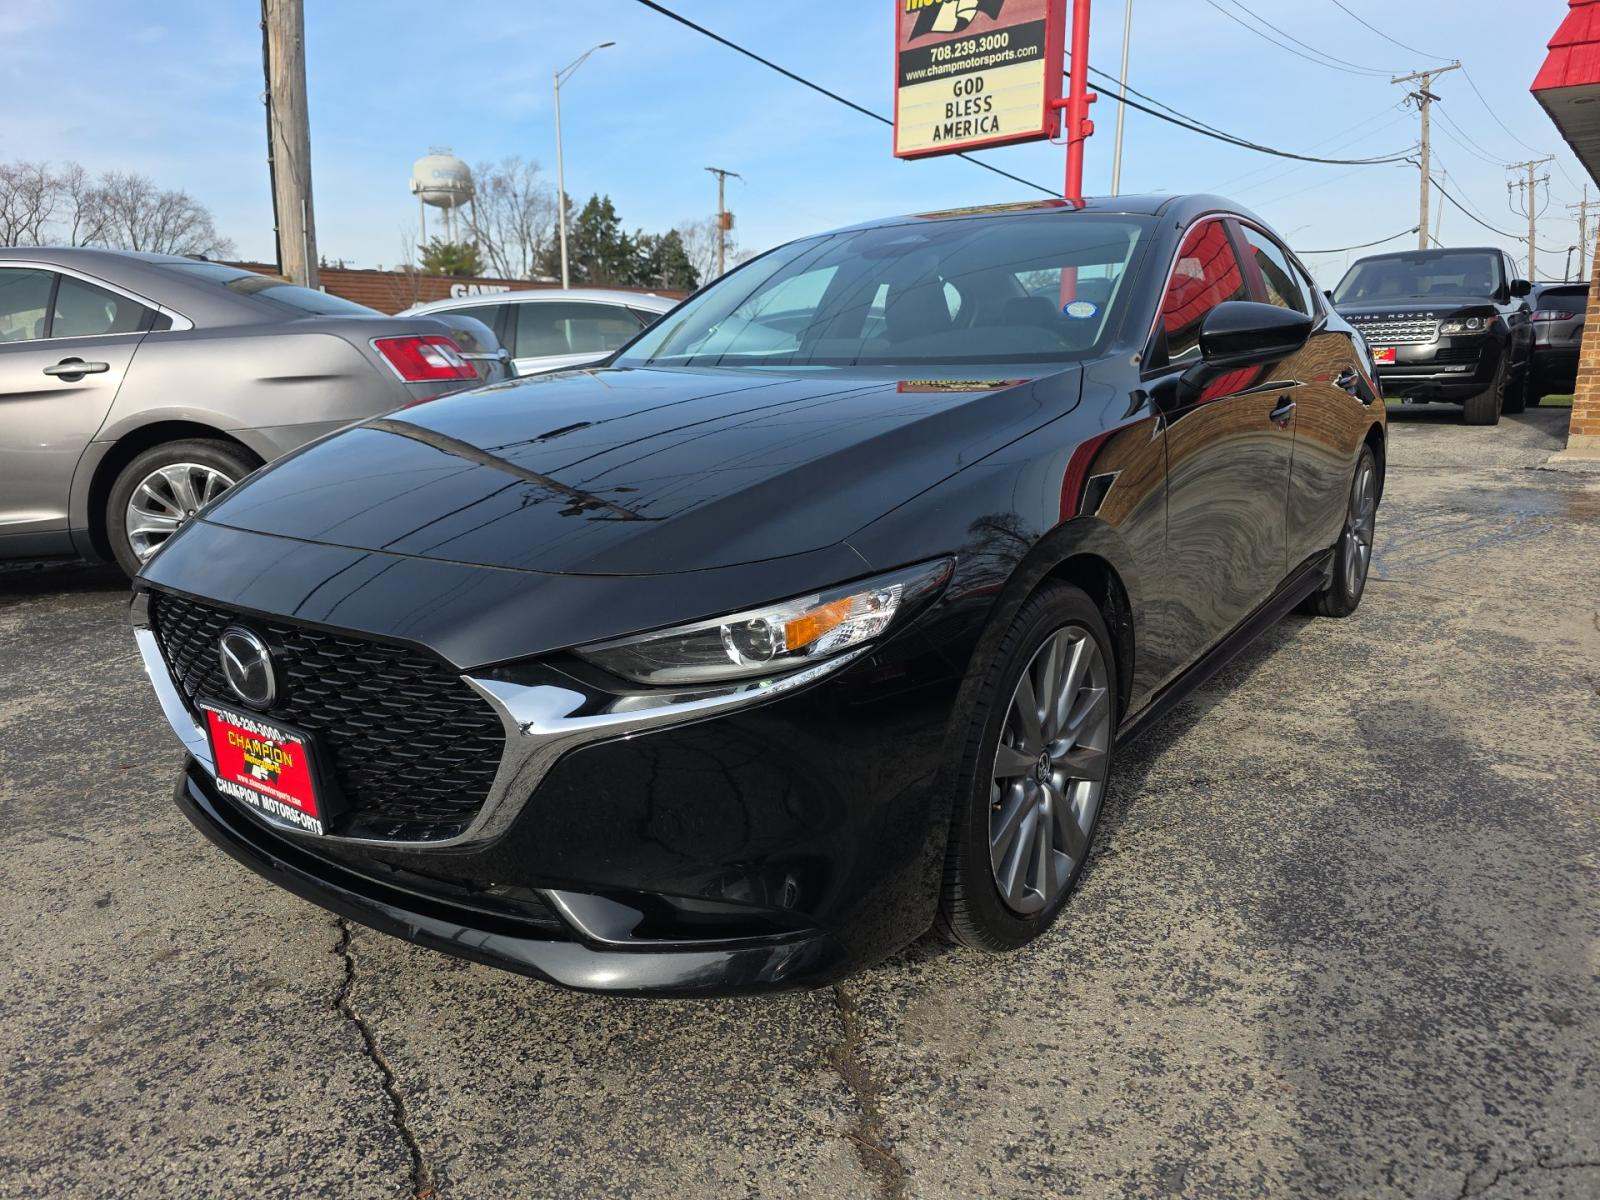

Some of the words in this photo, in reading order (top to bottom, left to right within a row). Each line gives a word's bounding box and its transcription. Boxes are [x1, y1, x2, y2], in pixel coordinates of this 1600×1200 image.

[930, 33, 1009, 62] 708.239.3000
[905, 45, 1038, 80] www.champmotorsports.com
[953, 77, 984, 97] GOD
[945, 95, 993, 119] BLESS
[933, 115, 1000, 141] AMERICA
[227, 731, 293, 767] CHAMPION
[216, 778, 260, 806] CHAMPION
[261, 794, 323, 836] MOTORSPORTS
